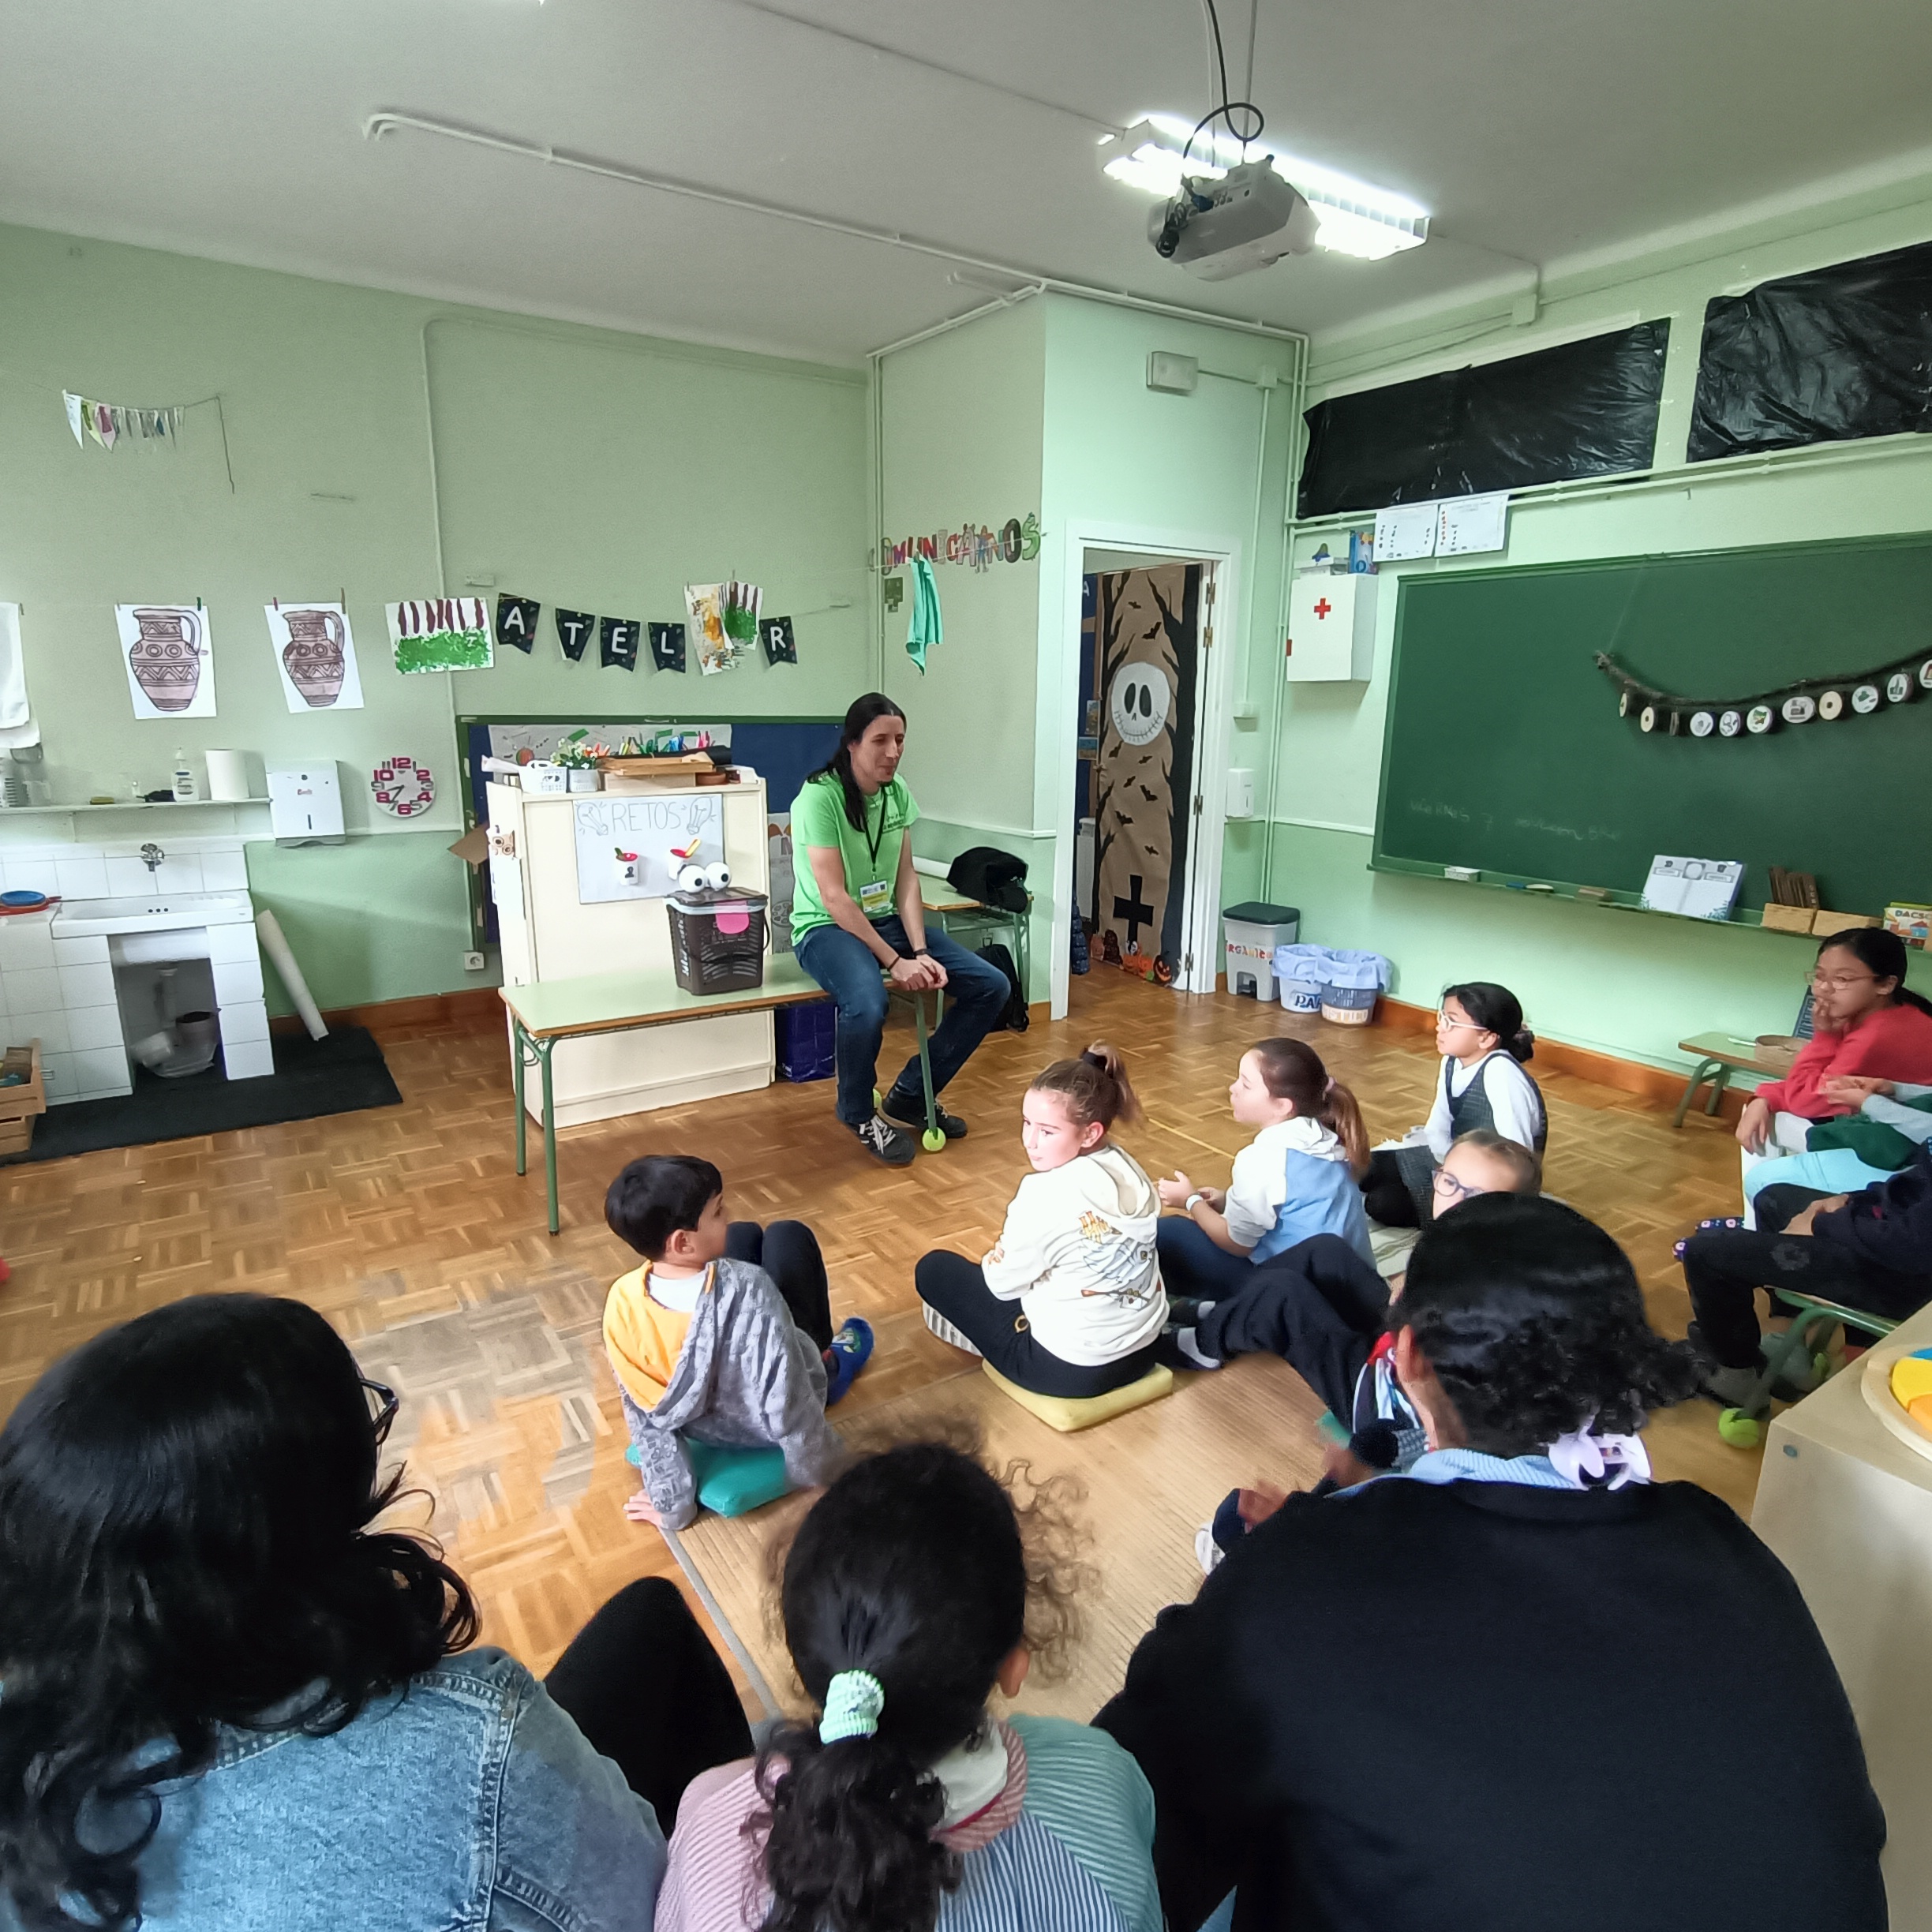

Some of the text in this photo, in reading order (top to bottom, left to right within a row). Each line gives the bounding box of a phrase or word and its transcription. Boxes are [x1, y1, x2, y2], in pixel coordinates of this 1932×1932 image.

[391, 758, 411, 769] 12
[373, 769, 395, 782] 10
[416, 769, 431, 781] 2
[371, 781, 385, 792] 9
[421, 781, 434, 791] 3
[376, 792, 390, 803] 8
[417, 792, 432, 803] 4
[398, 803, 412, 814] 6
[611, 802, 681, 832] RETOS
